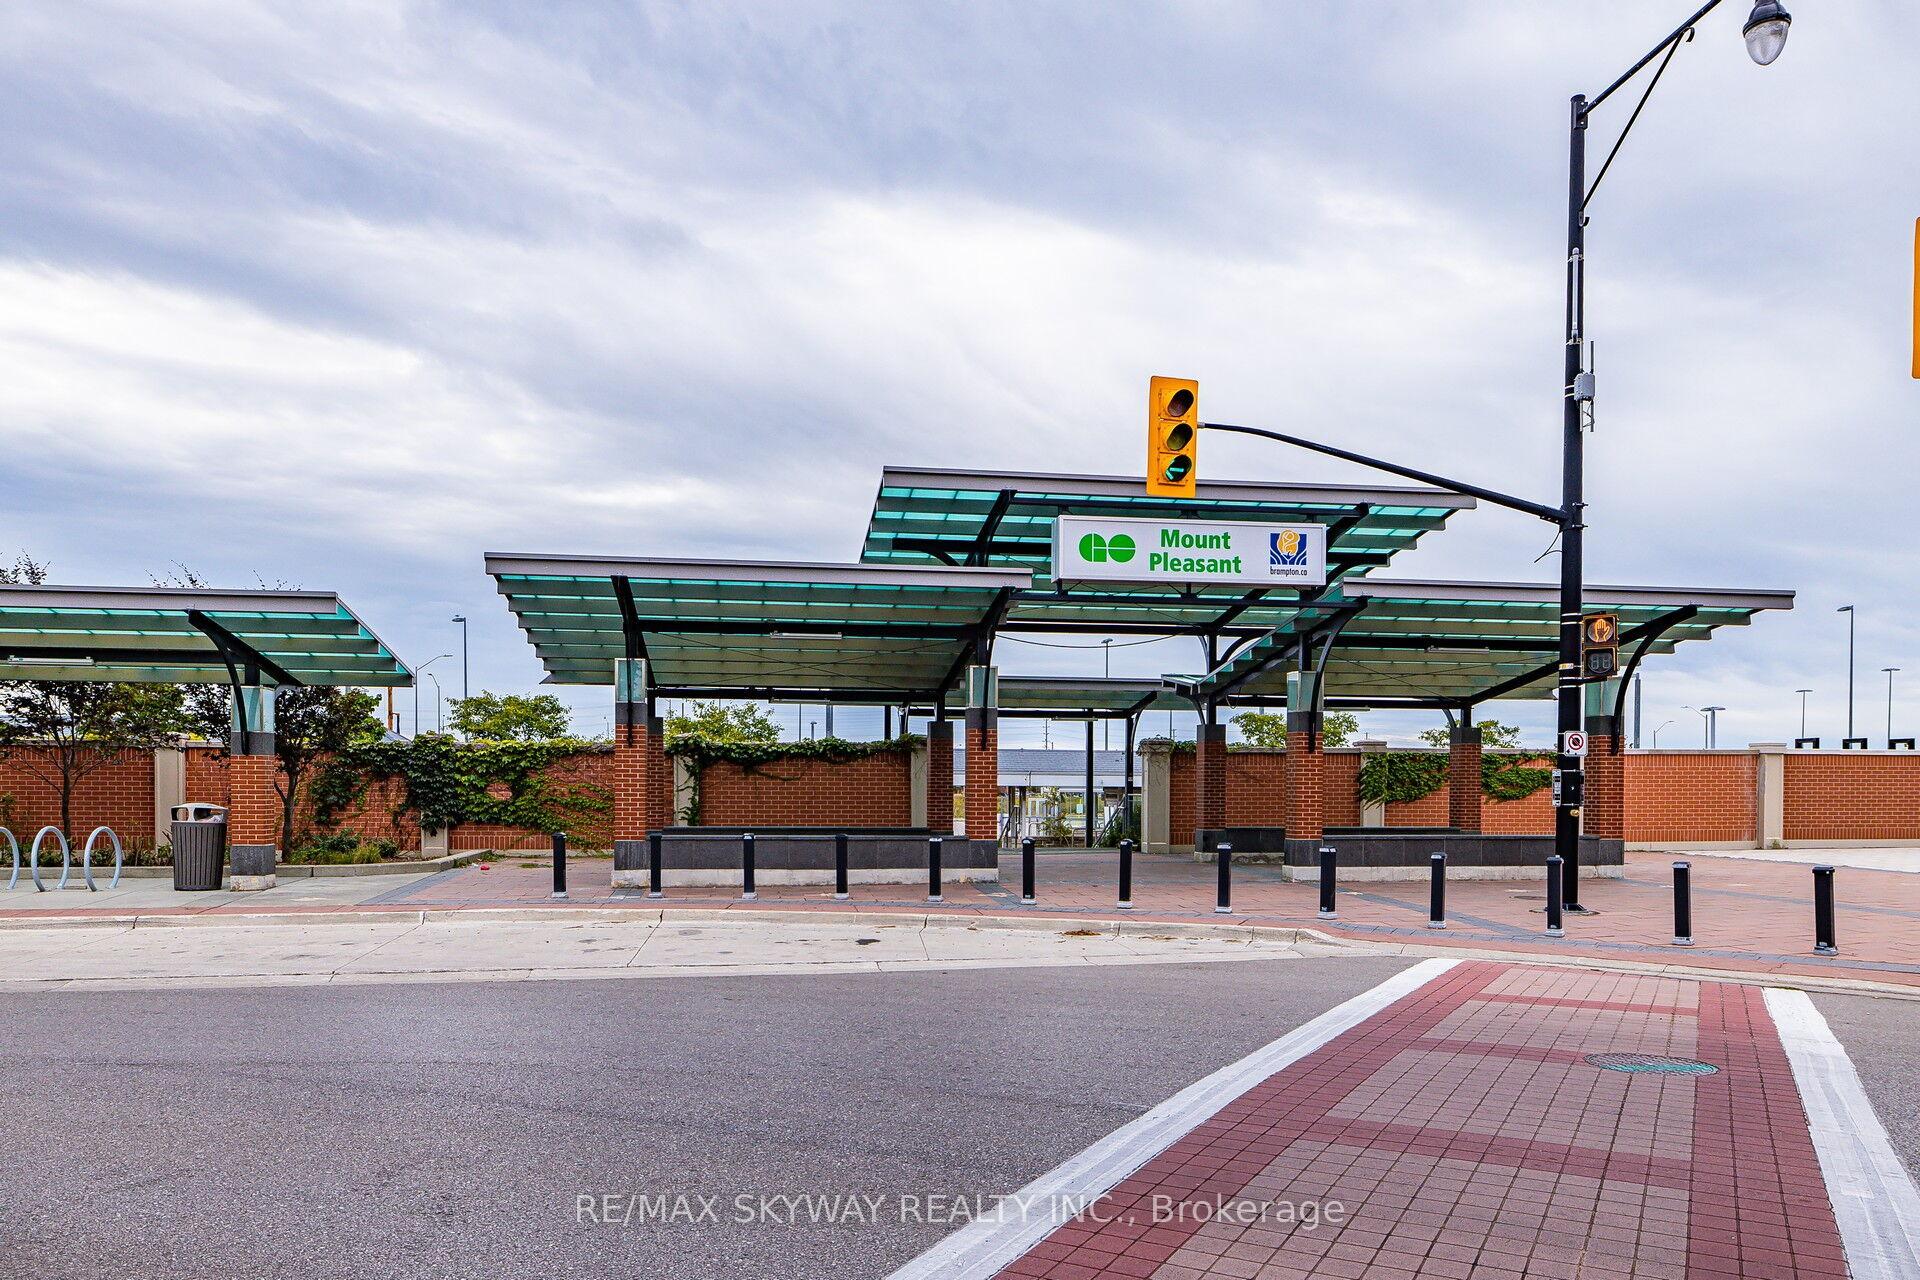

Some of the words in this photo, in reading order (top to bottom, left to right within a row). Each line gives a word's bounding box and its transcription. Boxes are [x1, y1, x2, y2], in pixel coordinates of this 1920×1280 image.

[1079, 533, 1136, 563] GO
[1160, 529, 1231, 550] Mount
[1149, 552, 1242, 574] Pleasant
